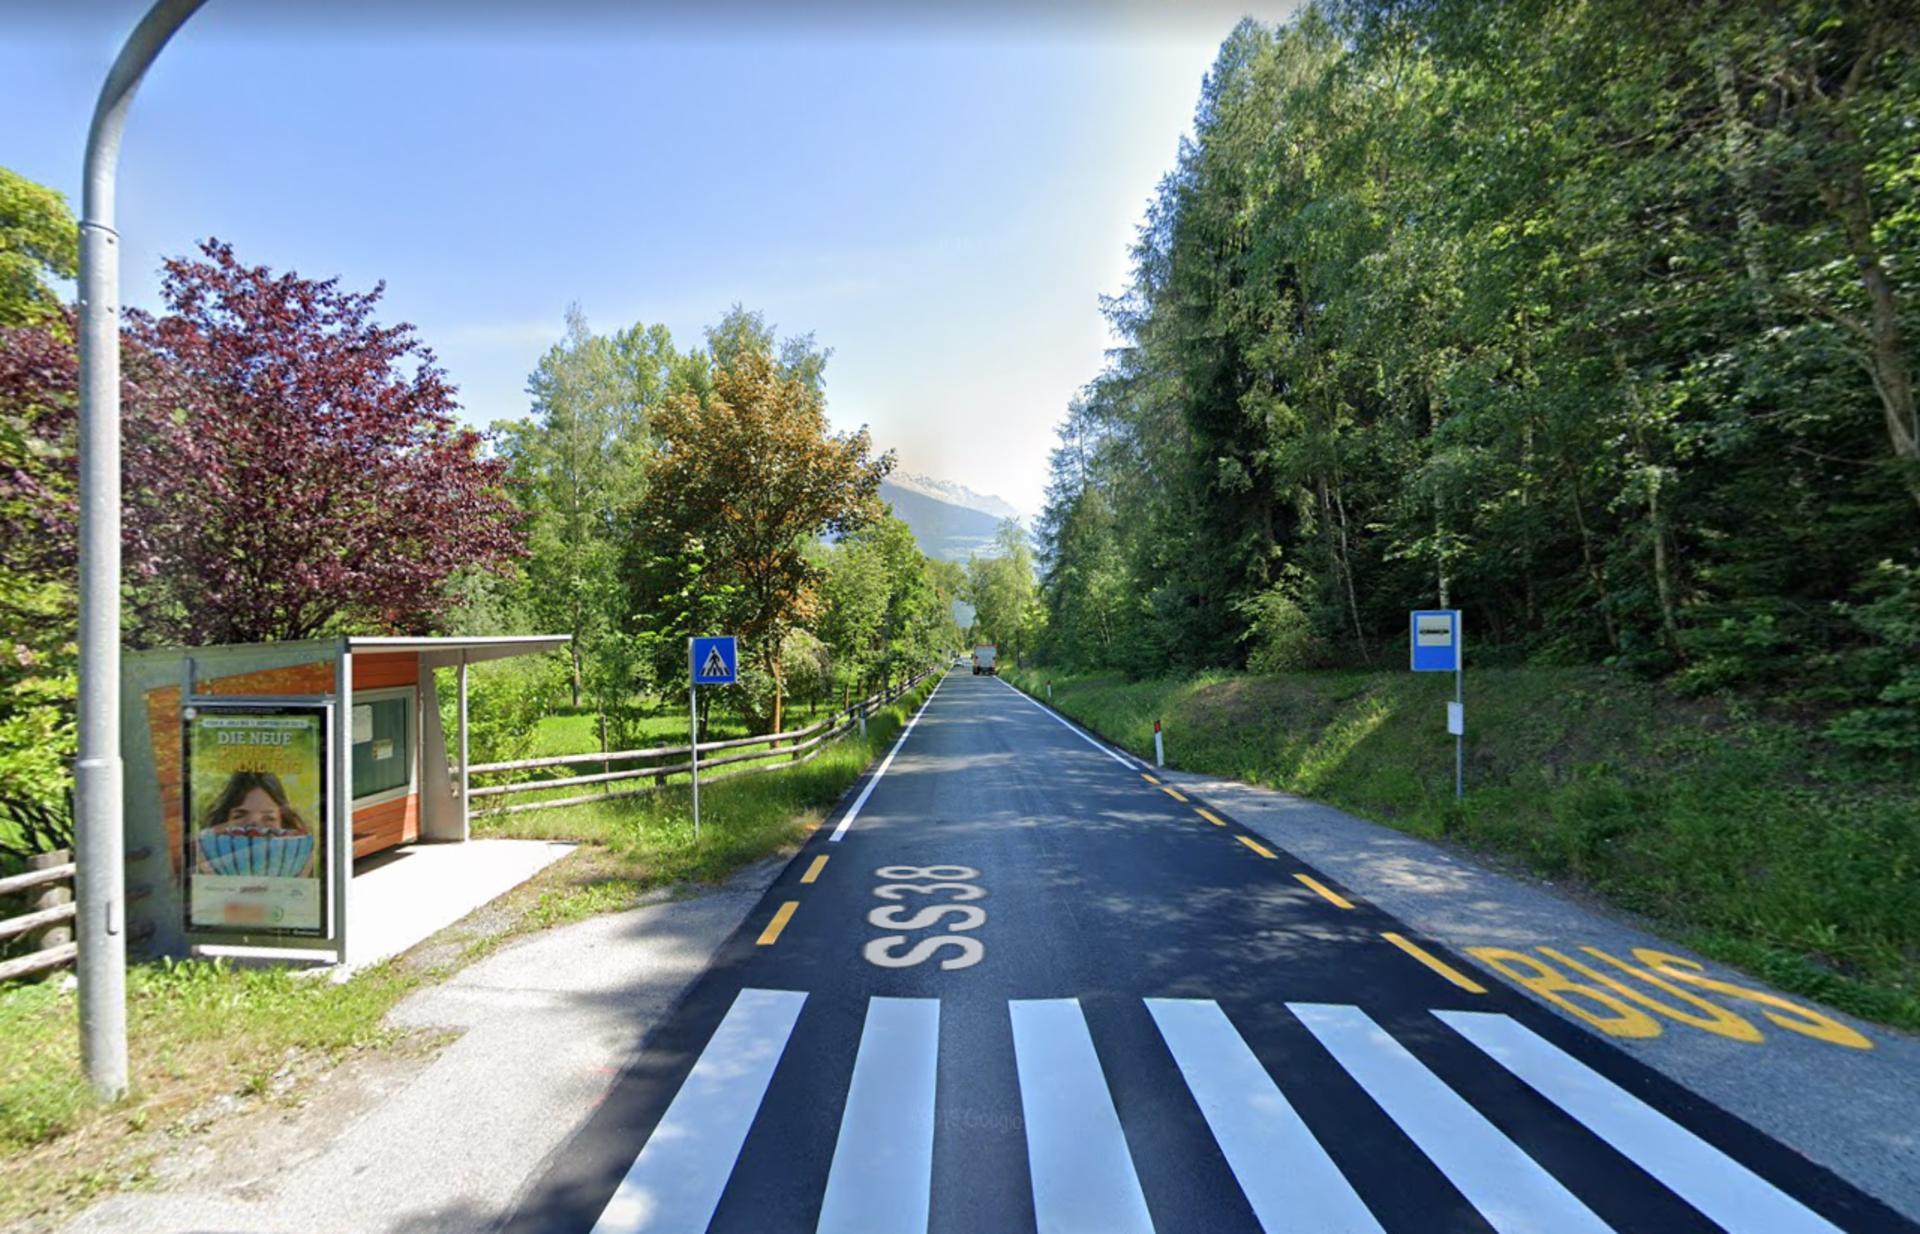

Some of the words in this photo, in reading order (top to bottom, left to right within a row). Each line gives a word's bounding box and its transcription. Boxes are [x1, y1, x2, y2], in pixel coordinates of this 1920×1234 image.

[217, 731, 246, 745] DIE
[250, 731, 293, 746] NEUE
[864, 864, 988, 970] SS38
[1462, 945, 1876, 1050] BUS
